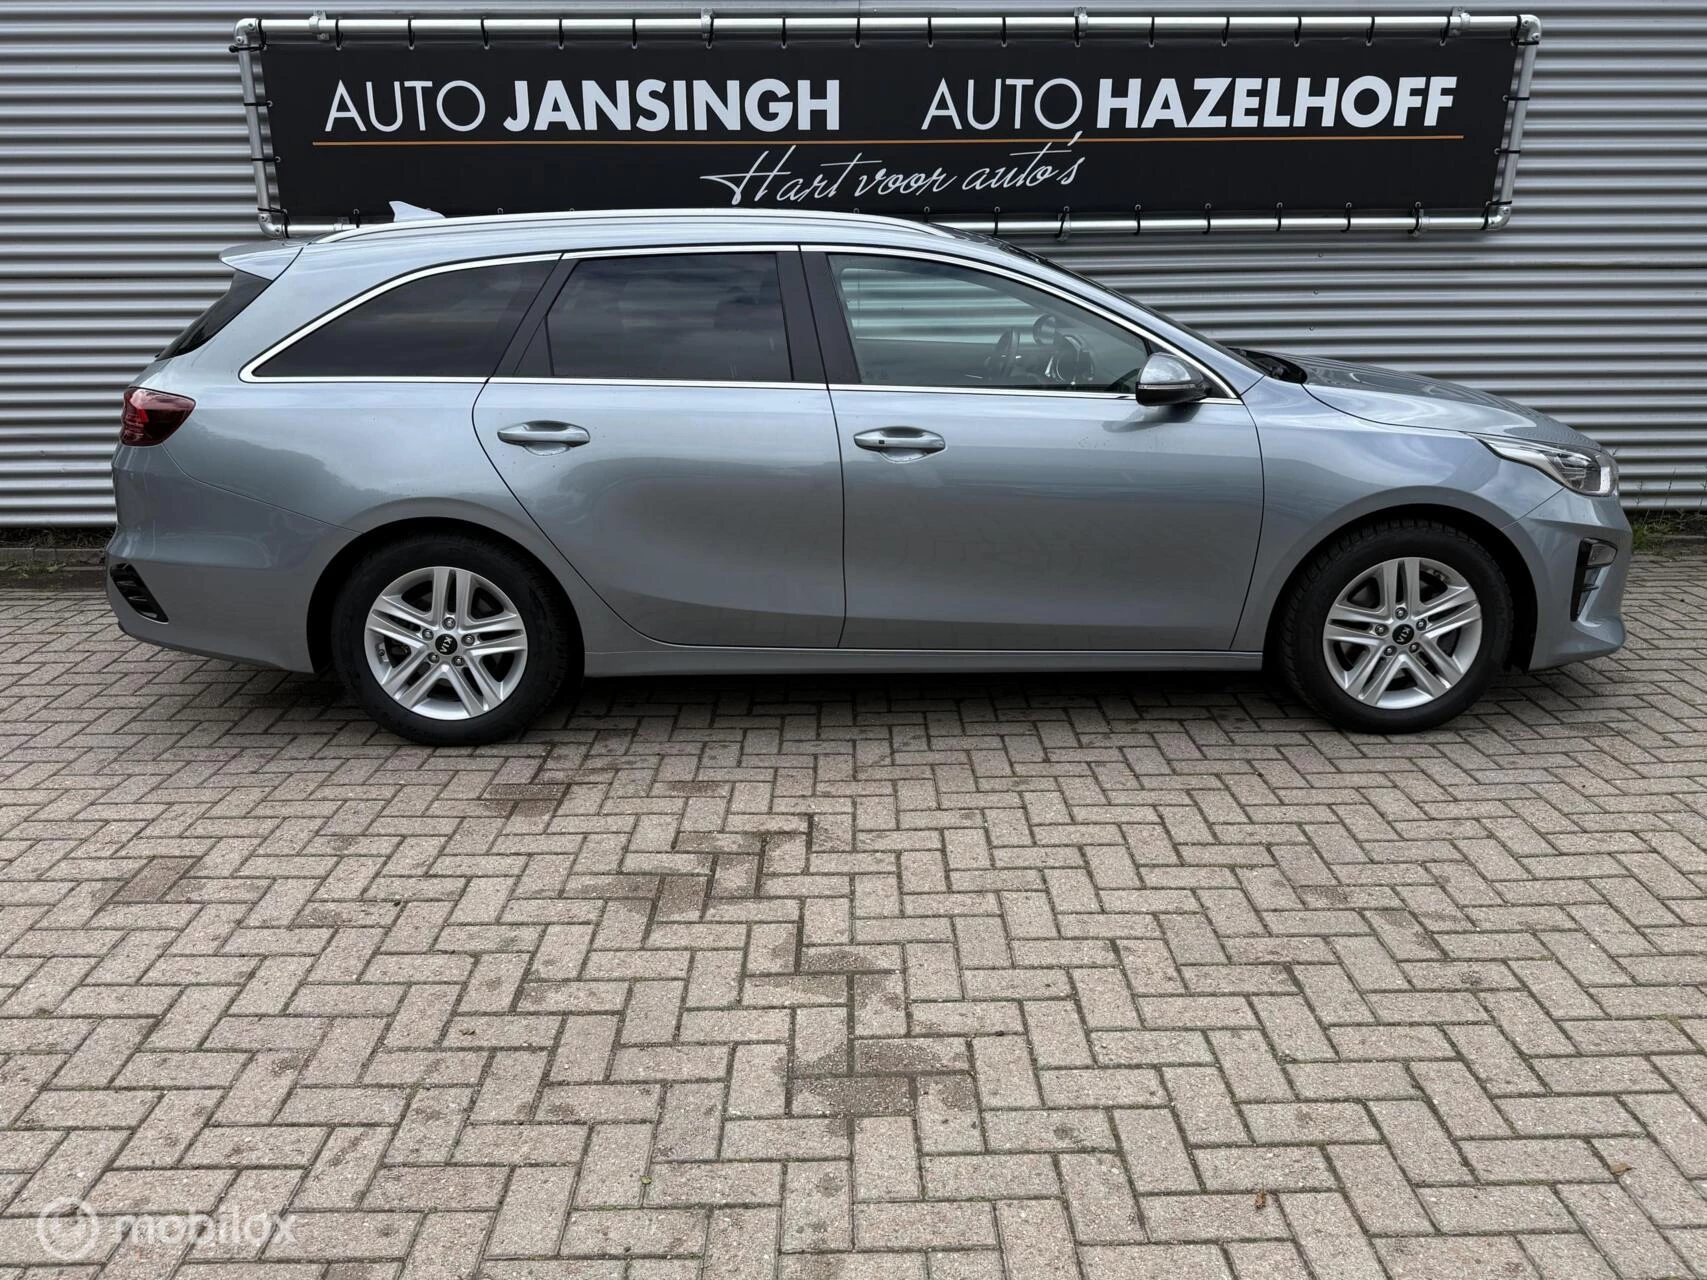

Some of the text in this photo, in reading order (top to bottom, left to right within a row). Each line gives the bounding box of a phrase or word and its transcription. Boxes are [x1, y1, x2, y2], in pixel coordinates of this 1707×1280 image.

[325, 79, 840, 132] AUTO JANSINGH
[920, 76, 1458, 131] AUTO HAZELHOFF
[700, 131, 1085, 205] Hart voor auto's
